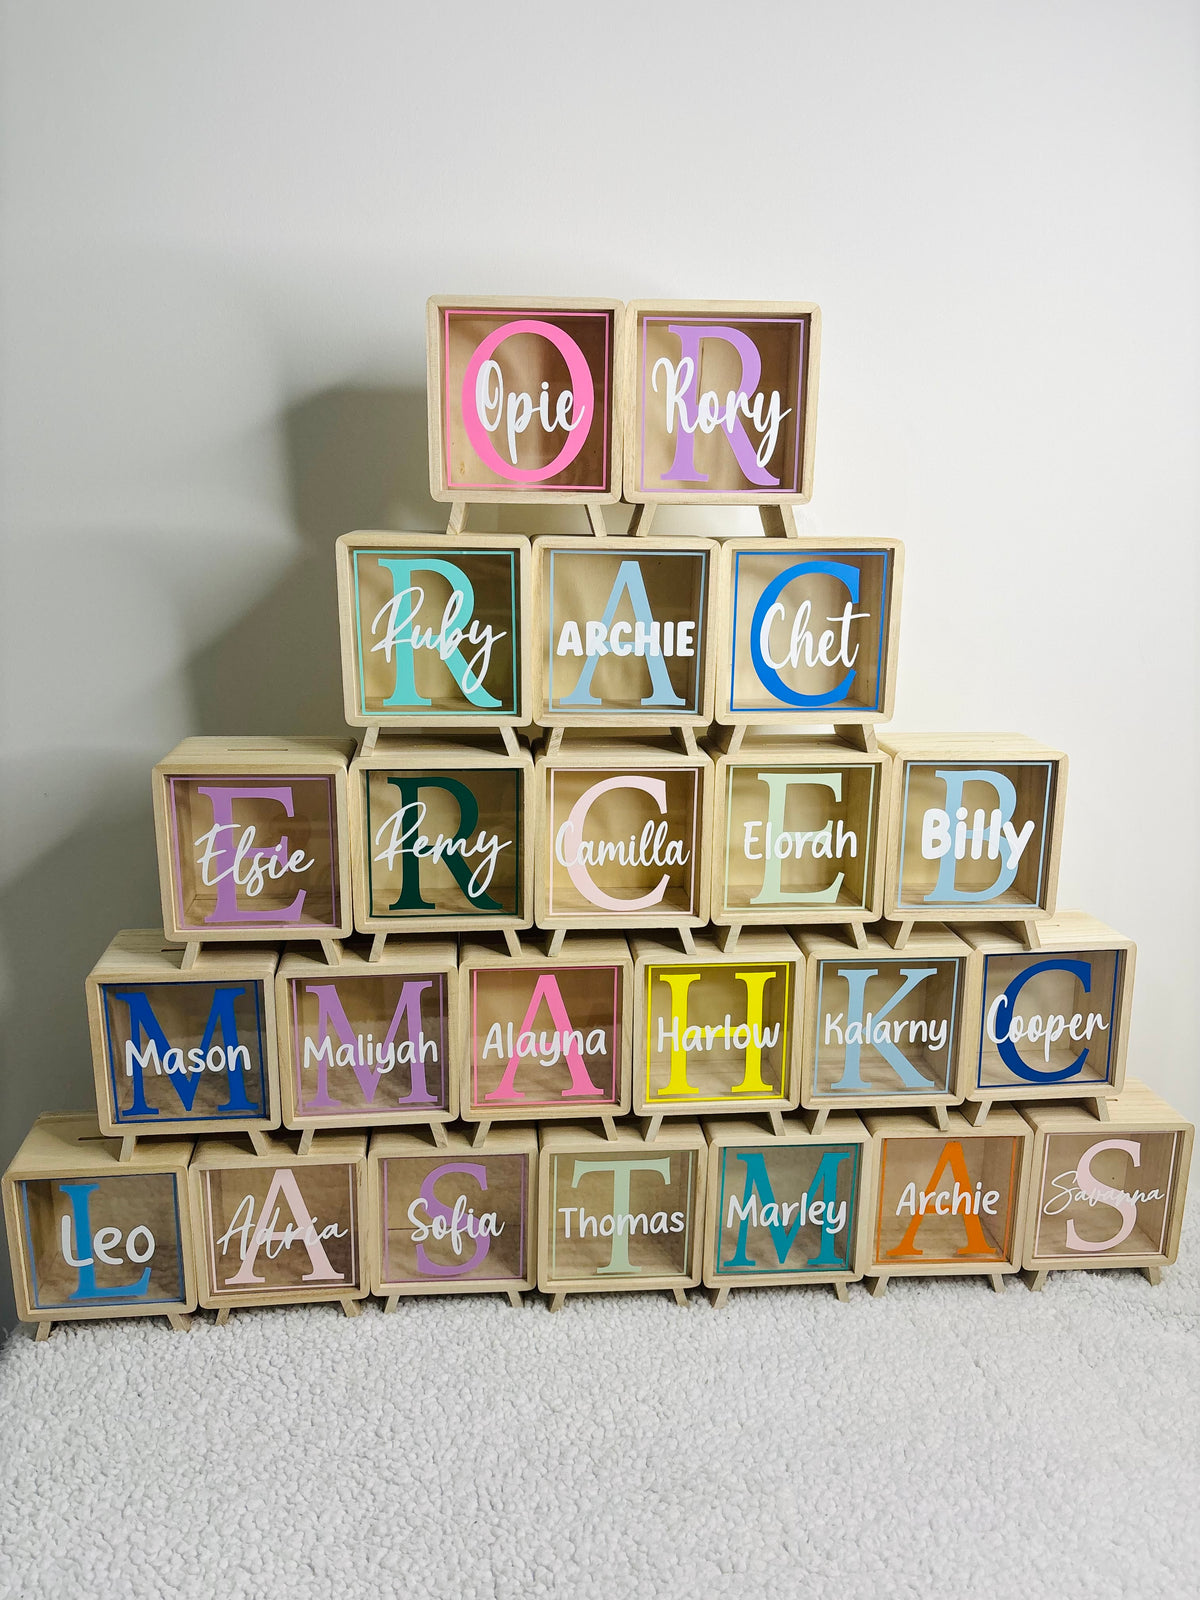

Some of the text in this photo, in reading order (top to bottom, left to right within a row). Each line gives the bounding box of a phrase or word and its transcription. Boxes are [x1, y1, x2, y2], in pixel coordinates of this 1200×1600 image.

[461, 320, 594, 482] O
[475, 359, 585, 464] Opie
[652, 356, 792, 468] Rory
[660, 324, 780, 486] R
[371, 586, 507, 694] Ruby
[378, 558, 502, 708] R
[556, 620, 695, 657] ARCHIE
[560, 561, 686, 705] A
[750, 560, 860, 707] C
[760, 600, 870, 670] Chet
[194, 823, 315, 897] Elsie
[198, 786, 307, 923] E
[374, 801, 512, 898] Remy
[387, 777, 503, 910] R
[555, 820, 690, 867] Camilla
[566, 775, 670, 911] C
[743, 820, 857, 860] Elorah
[750, 772, 845, 904] E
[921, 807, 1035, 870] Billy
[924, 769, 1018, 902] B
[116, 987, 258, 1116] M
[125, 1038, 251, 1077] Mason
[303, 1031, 438, 1074] Maliyah
[306, 980, 438, 1108] M
[482, 1021, 607, 1067] Alayna
[485, 974, 604, 1100] A
[657, 971, 776, 1095] H
[657, 1013, 780, 1053] Harlow
[824, 1012, 948, 1051] Kalarny
[830, 968, 938, 1089] K
[987, 994, 1109, 1062] Cooper
[995, 959, 1091, 1083] C
[59, 1183, 152, 1300] L
[61, 1214, 156, 1267] Leo
[216, 1194, 348, 1261] Adria
[224, 1168, 345, 1285] A
[407, 1194, 505, 1256] Sofia
[415, 1162, 490, 1275] S
[558, 1207, 685, 1239] Thomas
[571, 1156, 671, 1274] T
[723, 1152, 850, 1267] M
[727, 1192, 847, 1234] Marley
[886, 1141, 996, 1256] A
[896, 1181, 1000, 1216] Archie
[1043, 1170, 1165, 1215] Savanna
[1065, 1138, 1141, 1252] S
